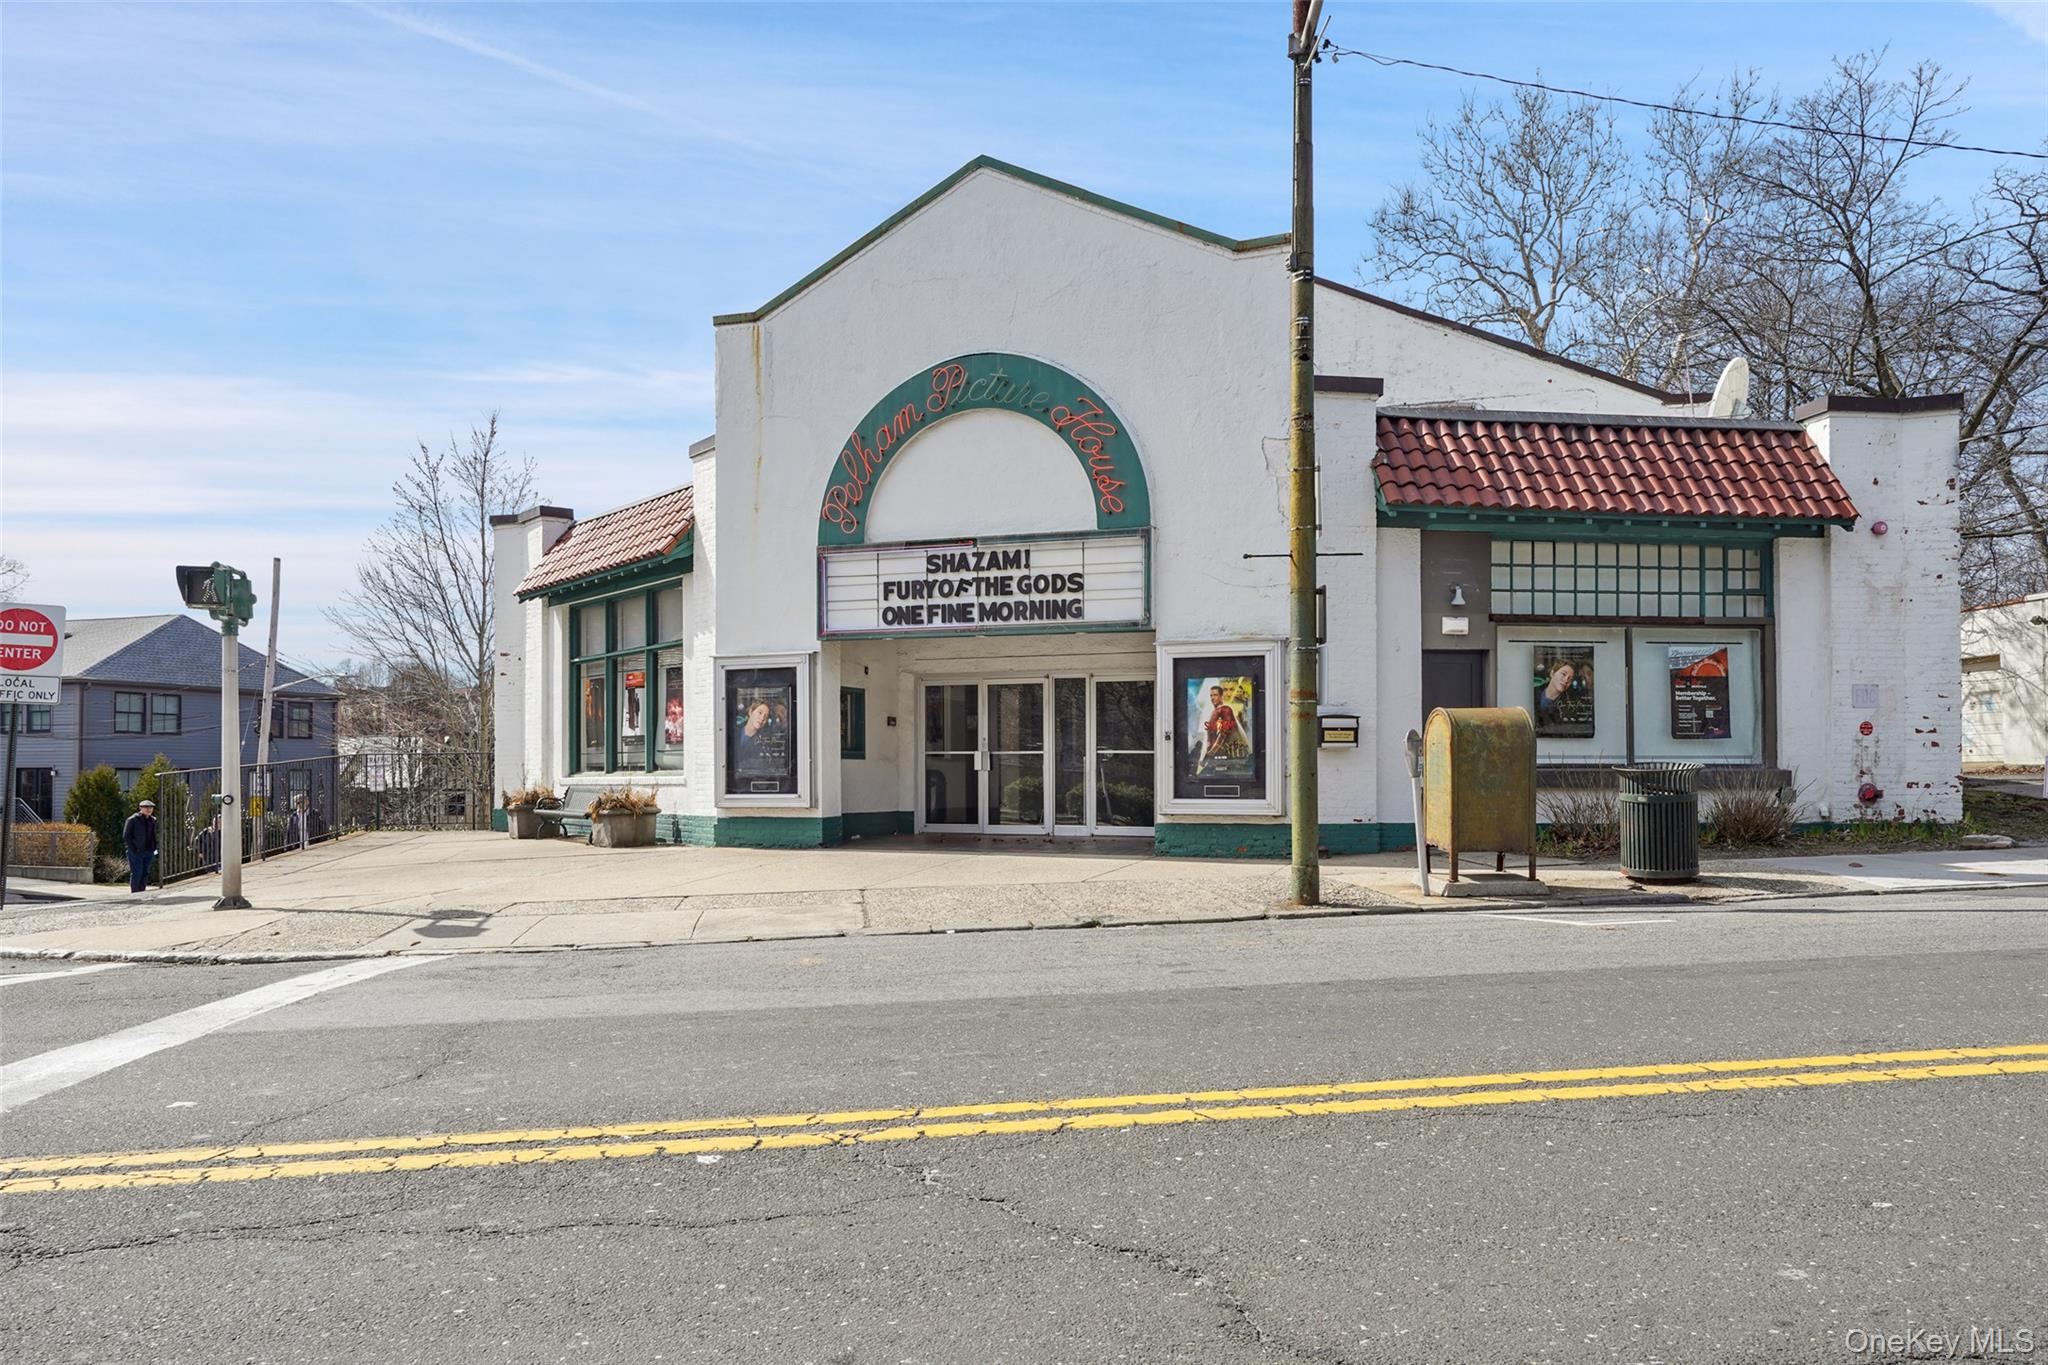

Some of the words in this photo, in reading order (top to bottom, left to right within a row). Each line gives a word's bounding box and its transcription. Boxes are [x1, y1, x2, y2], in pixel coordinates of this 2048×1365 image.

[822, 403, 924, 534] Pelham
[926, 363, 1051, 413] Picture
[1051, 396, 1126, 514] House
[926, 549, 1031, 574] SHAZAM!
[1016, 572, 1084, 595] GODS
[882, 604, 925, 626] ONE
[927, 602, 976, 624] FINE
[978, 598, 1083, 623] MORNING
[19, 621, 47, 633] NOT
[28, 690, 56, 701] ONLY
